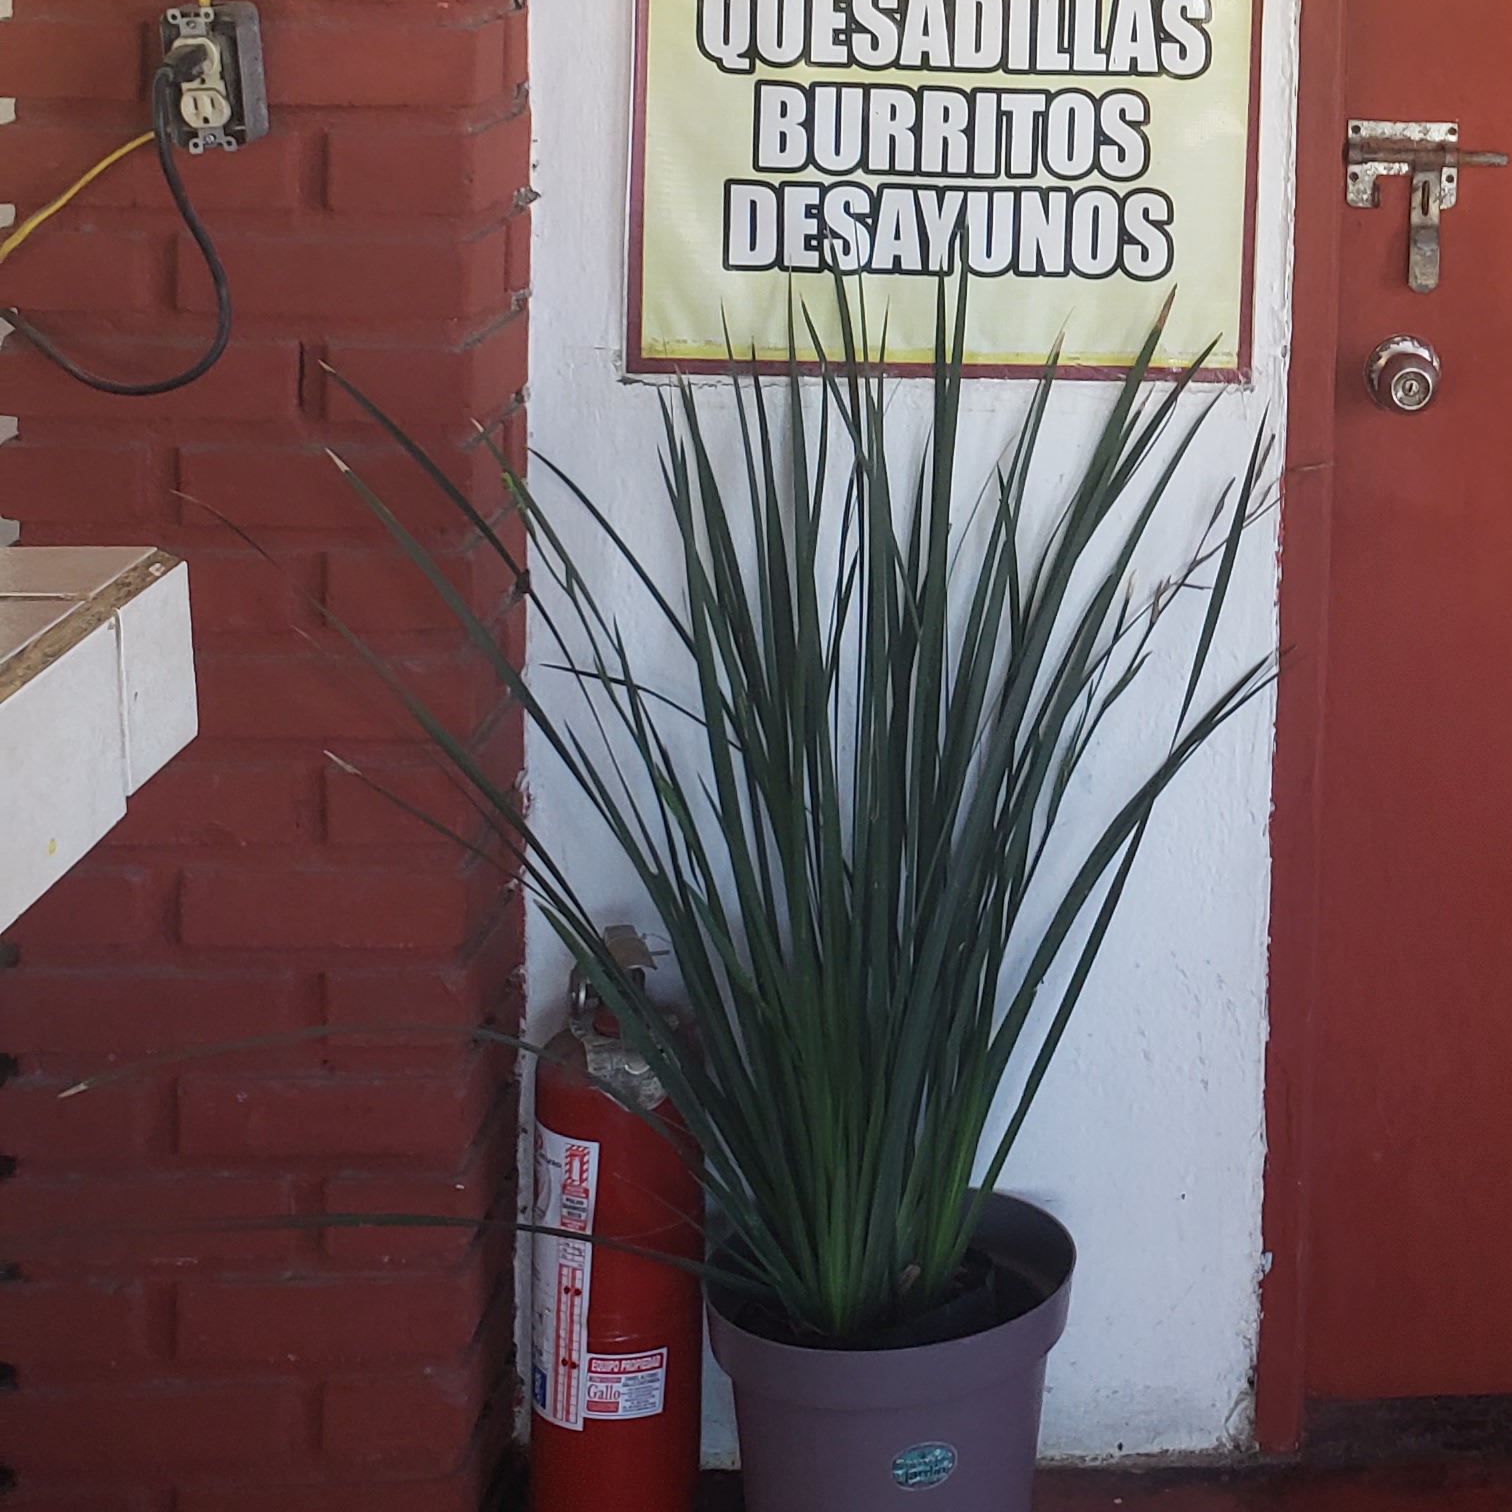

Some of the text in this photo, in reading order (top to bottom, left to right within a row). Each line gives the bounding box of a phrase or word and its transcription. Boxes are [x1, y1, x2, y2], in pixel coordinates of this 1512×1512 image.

[753, 79, 1152, 181] BURRITOS
[722, 177, 1175, 281] DESAYUNOS
[587, 1383, 621, 1400] Gallo
